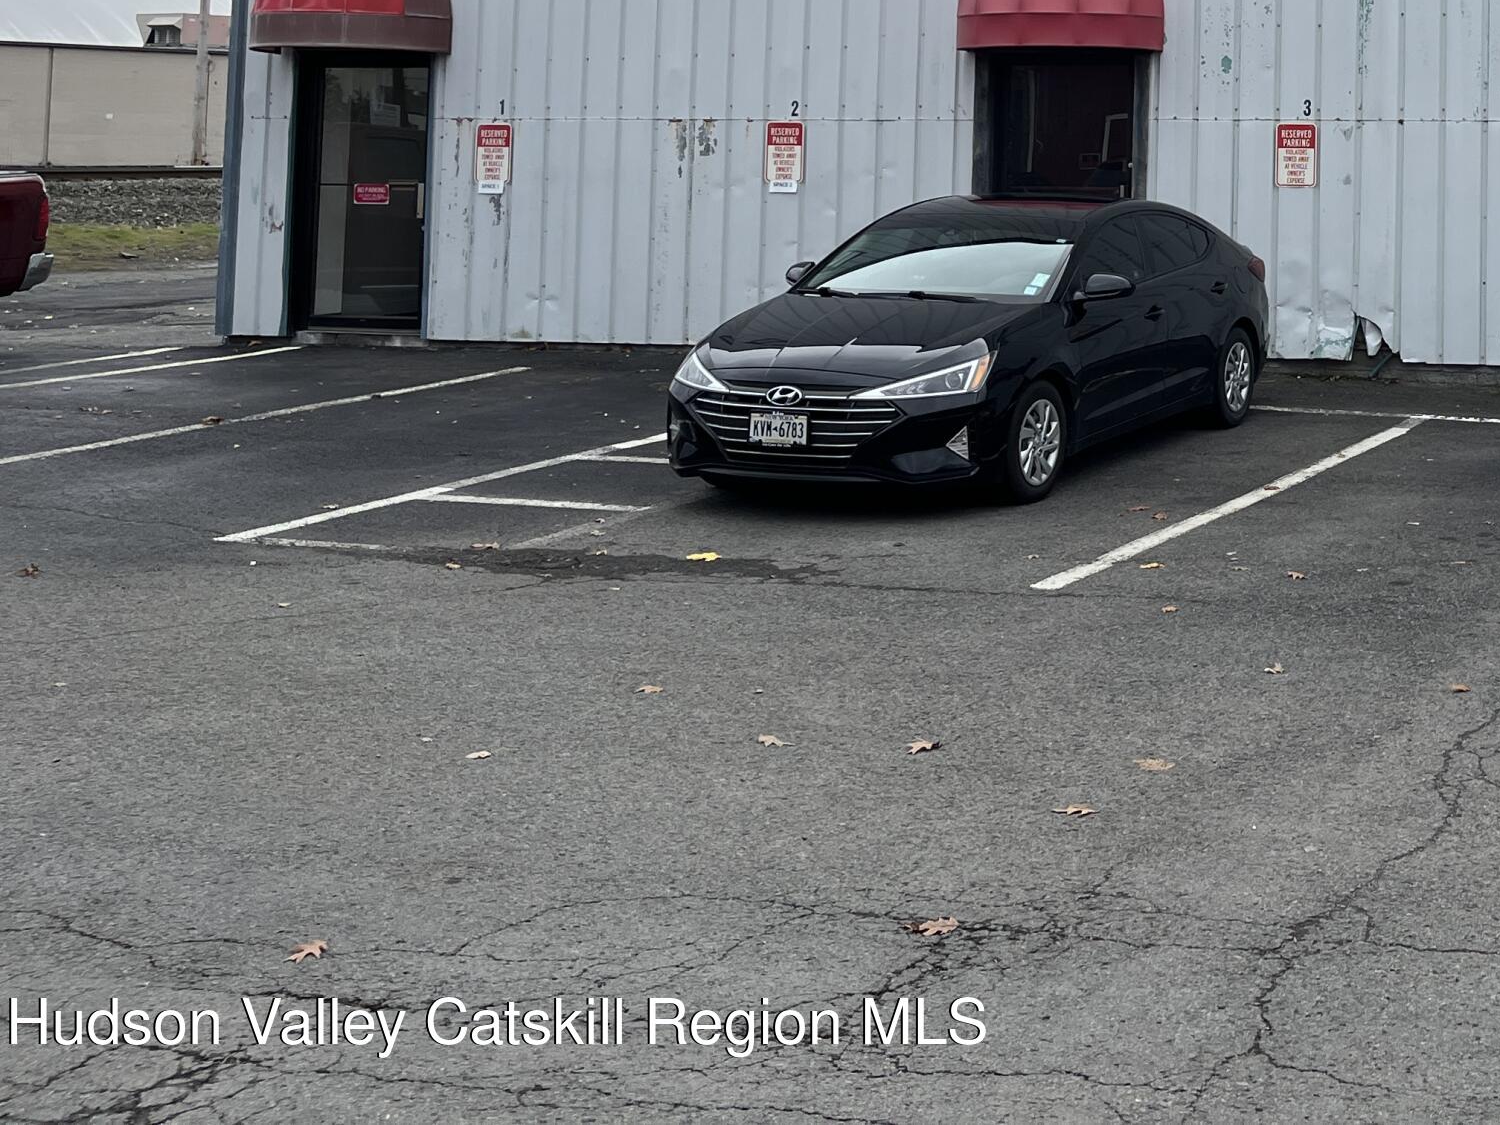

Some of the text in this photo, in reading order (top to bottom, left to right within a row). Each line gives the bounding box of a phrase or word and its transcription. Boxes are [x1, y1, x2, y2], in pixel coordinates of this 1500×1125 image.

[500, 99, 505, 115] 1
[791, 100, 799, 117] 2
[1303, 99, 1312, 116] 3
[481, 130, 508, 138] RESERVED
[770, 128, 800, 136] RESERVED
[1281, 130, 1312, 138] RESERVED
[482, 138, 506, 146] PARKING
[1283, 139, 1310, 147] PARKING
[779, 421, 804, 439] 6783
